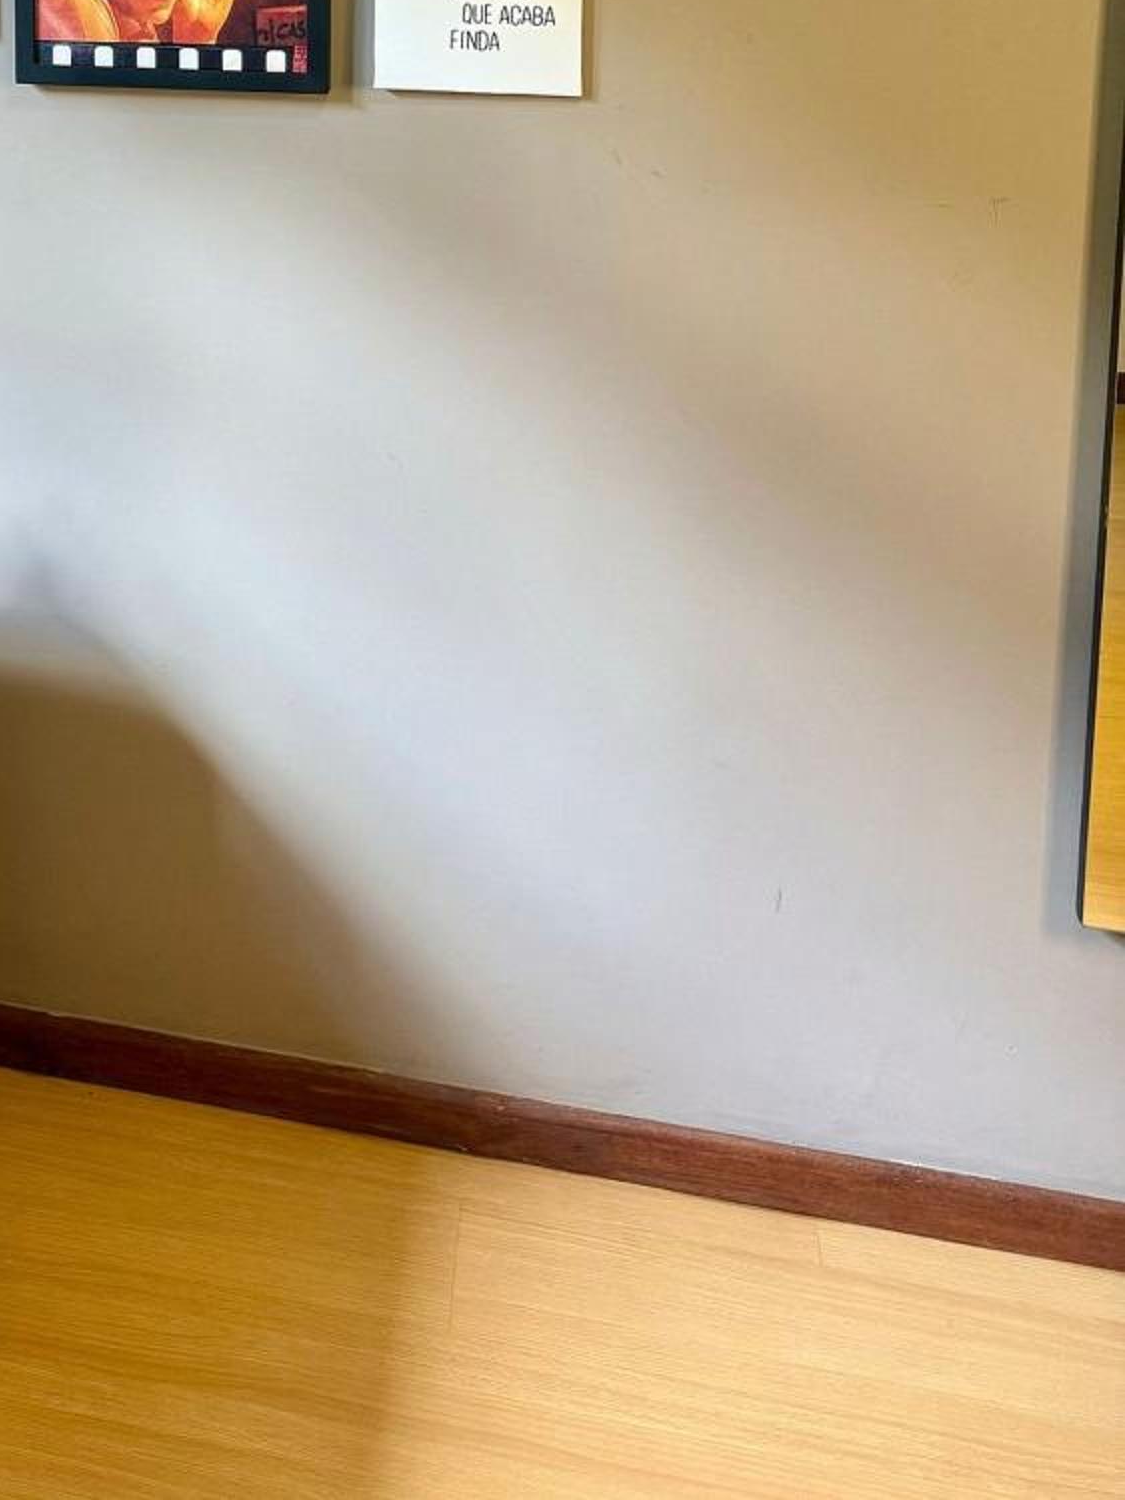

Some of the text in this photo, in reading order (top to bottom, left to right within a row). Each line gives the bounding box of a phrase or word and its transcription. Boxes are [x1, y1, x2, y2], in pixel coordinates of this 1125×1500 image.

[462, 3, 556, 27] QUE ACABA
[449, 29, 500, 51] FINDA
